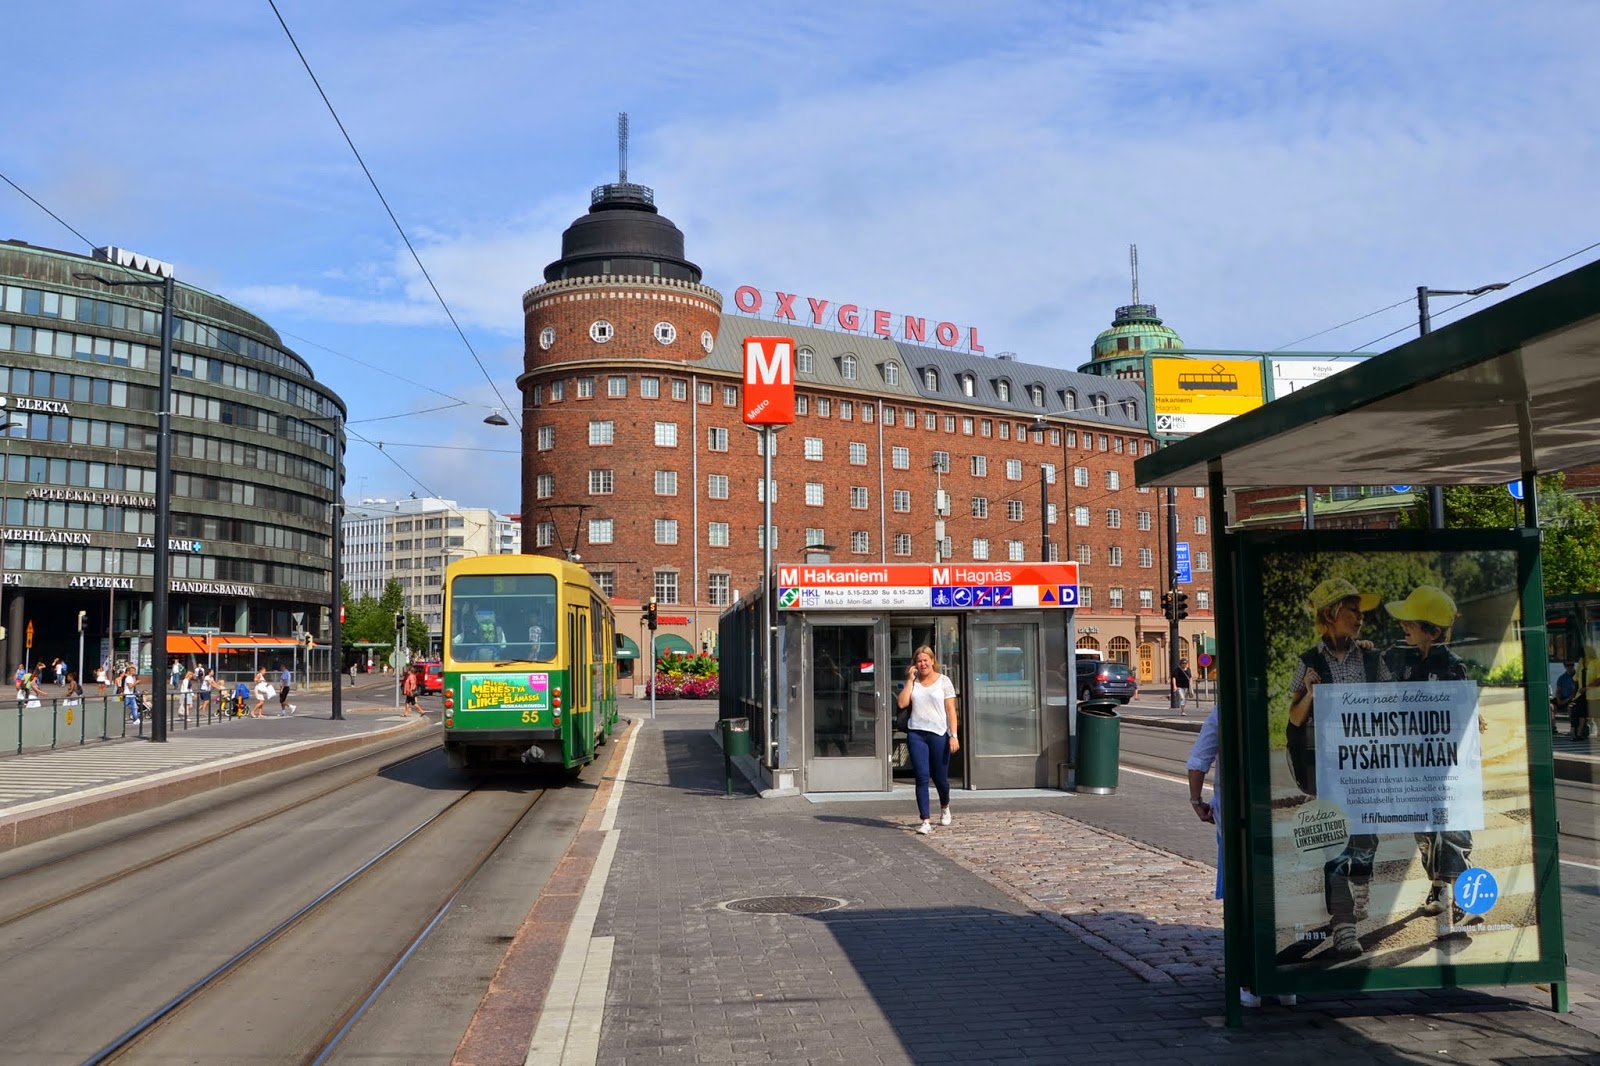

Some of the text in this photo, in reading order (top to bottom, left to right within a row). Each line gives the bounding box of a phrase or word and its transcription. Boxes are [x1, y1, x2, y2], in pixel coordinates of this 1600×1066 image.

[734, 285, 985, 352] OXYGENOL
[746, 342, 791, 385] M
[1275, 363, 1281, 377] 1
[15, 398, 69, 414] ELEKTA
[747, 399, 769, 420] Metro
[1, 529, 91, 544] MEHILÄINEN
[70, 577, 134, 589] APTEEKKI
[780, 568, 888, 585] M Hakaniemi
[932, 568, 1012, 585] M Hagnäs
[171, 581, 255, 596] HANDELSBANKEN
[801, 589, 820, 597] HKL
[1063, 589, 1074, 602] D
[801, 598, 820, 606] HST
[471, 685, 525, 693] MENESTYÄ
[468, 694, 540, 709] LIIKE-ELÄMÄSSÄ
[1342, 692, 1370, 705] Kun
[1402, 690, 1450, 703] keltaista
[522, 711, 539, 723] 55
[1341, 710, 1451, 738] VALMISTAUDU
[1338, 737, 1458, 770] PYSÄHTYMÄÄN
[1340, 776, 1377, 785] Keltanokat
[1380, 775, 1403, 783] tulevat
[1423, 774, 1459, 782] Annamme
[1404, 784, 1436, 794] jokaiselle
[1298, 810, 1337, 825] Testaa
[1294, 819, 1346, 838] PERHEESI TIEDOT
